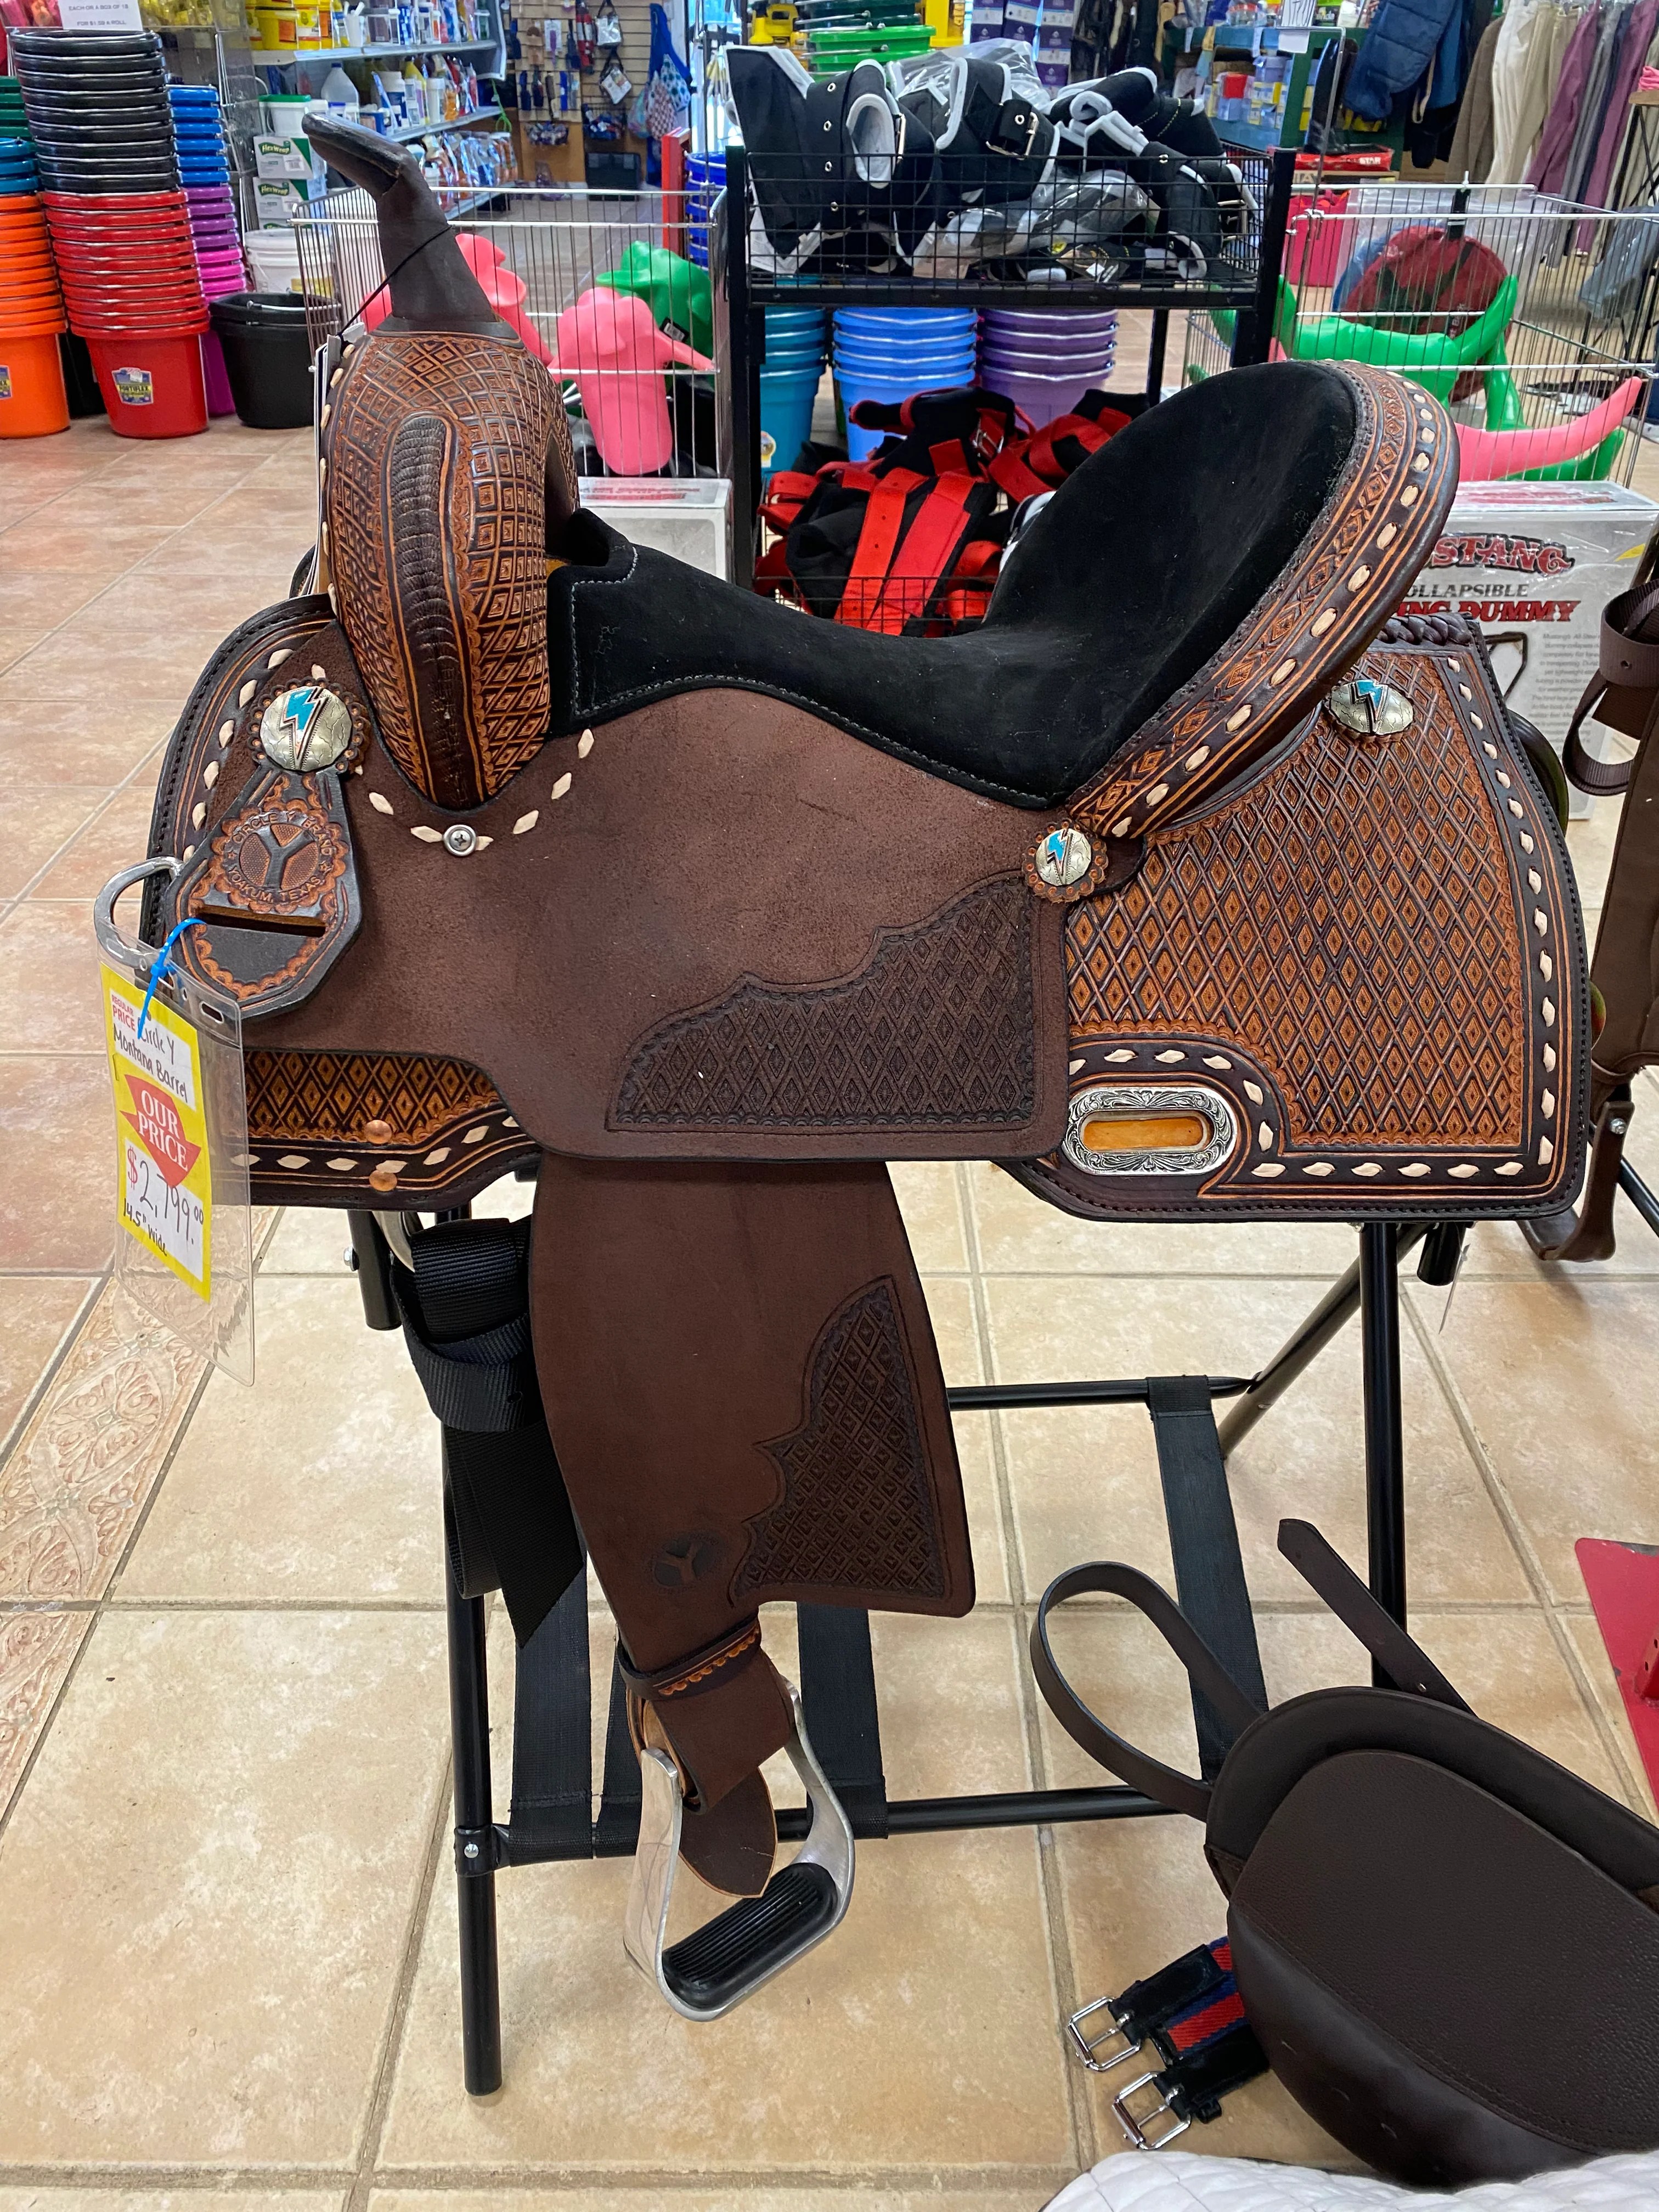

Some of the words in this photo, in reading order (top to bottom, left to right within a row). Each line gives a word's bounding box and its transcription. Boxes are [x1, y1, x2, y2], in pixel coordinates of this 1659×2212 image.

[1431, 535, 1573, 576] STANG
[1407, 584, 1530, 597] OLLAPSIBLE
[1459, 600, 1582, 622] DUMMY
[233, 812, 278, 844] CIRCLE
[287, 810, 296, 822] Y
[302, 817, 333, 856] BRAND
[280, 876, 321, 901] TEXAS
[111, 995, 133, 1017] REGULAR
[112, 1005, 136, 1032] PRICE
[113, 1023, 154, 1075] Montana
[156, 1059, 188, 1103] Barrel
[166, 1035, 174, 1065] Y
[141, 1089, 180, 1139] OUR
[138, 1110, 188, 1172] PRICE
